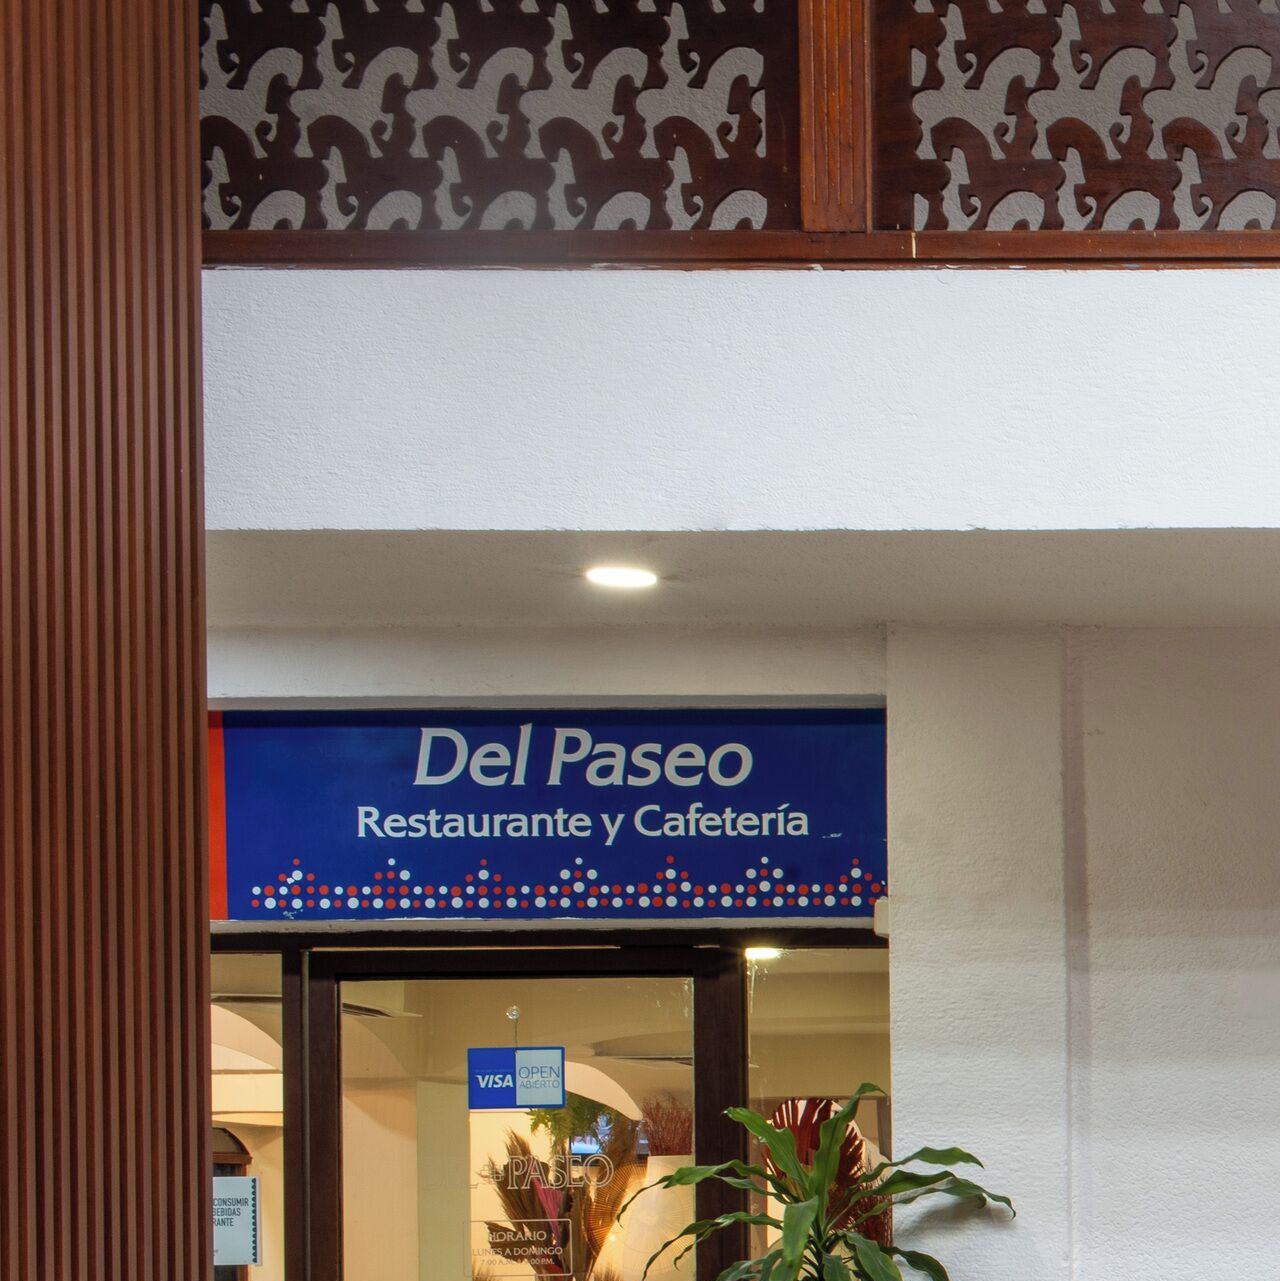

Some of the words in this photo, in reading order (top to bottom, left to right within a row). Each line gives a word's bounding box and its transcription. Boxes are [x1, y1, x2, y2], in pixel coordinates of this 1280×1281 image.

[412, 722, 533, 787] Del
[546, 726, 754, 788] Paseo
[356, 805, 592, 839] Restaurante
[599, 811, 624, 846] y
[633, 802, 810, 838] Cafetería
[518, 1066, 560, 1079] OPEN
[475, 1074, 514, 1089] VISA
[518, 1079, 560, 1089] ABIERTO
[507, 1153, 615, 1190] PASEO
[213, 1198, 249, 1207] CONSUMIR
[213, 1207, 242, 1217] BEBIDAS
[488, 1230, 547, 1242] HORARIO
[472, 1247, 503, 1257] LUNES
[504, 1248, 512, 1256] A
[513, 1246, 564, 1256] DOMINGO
